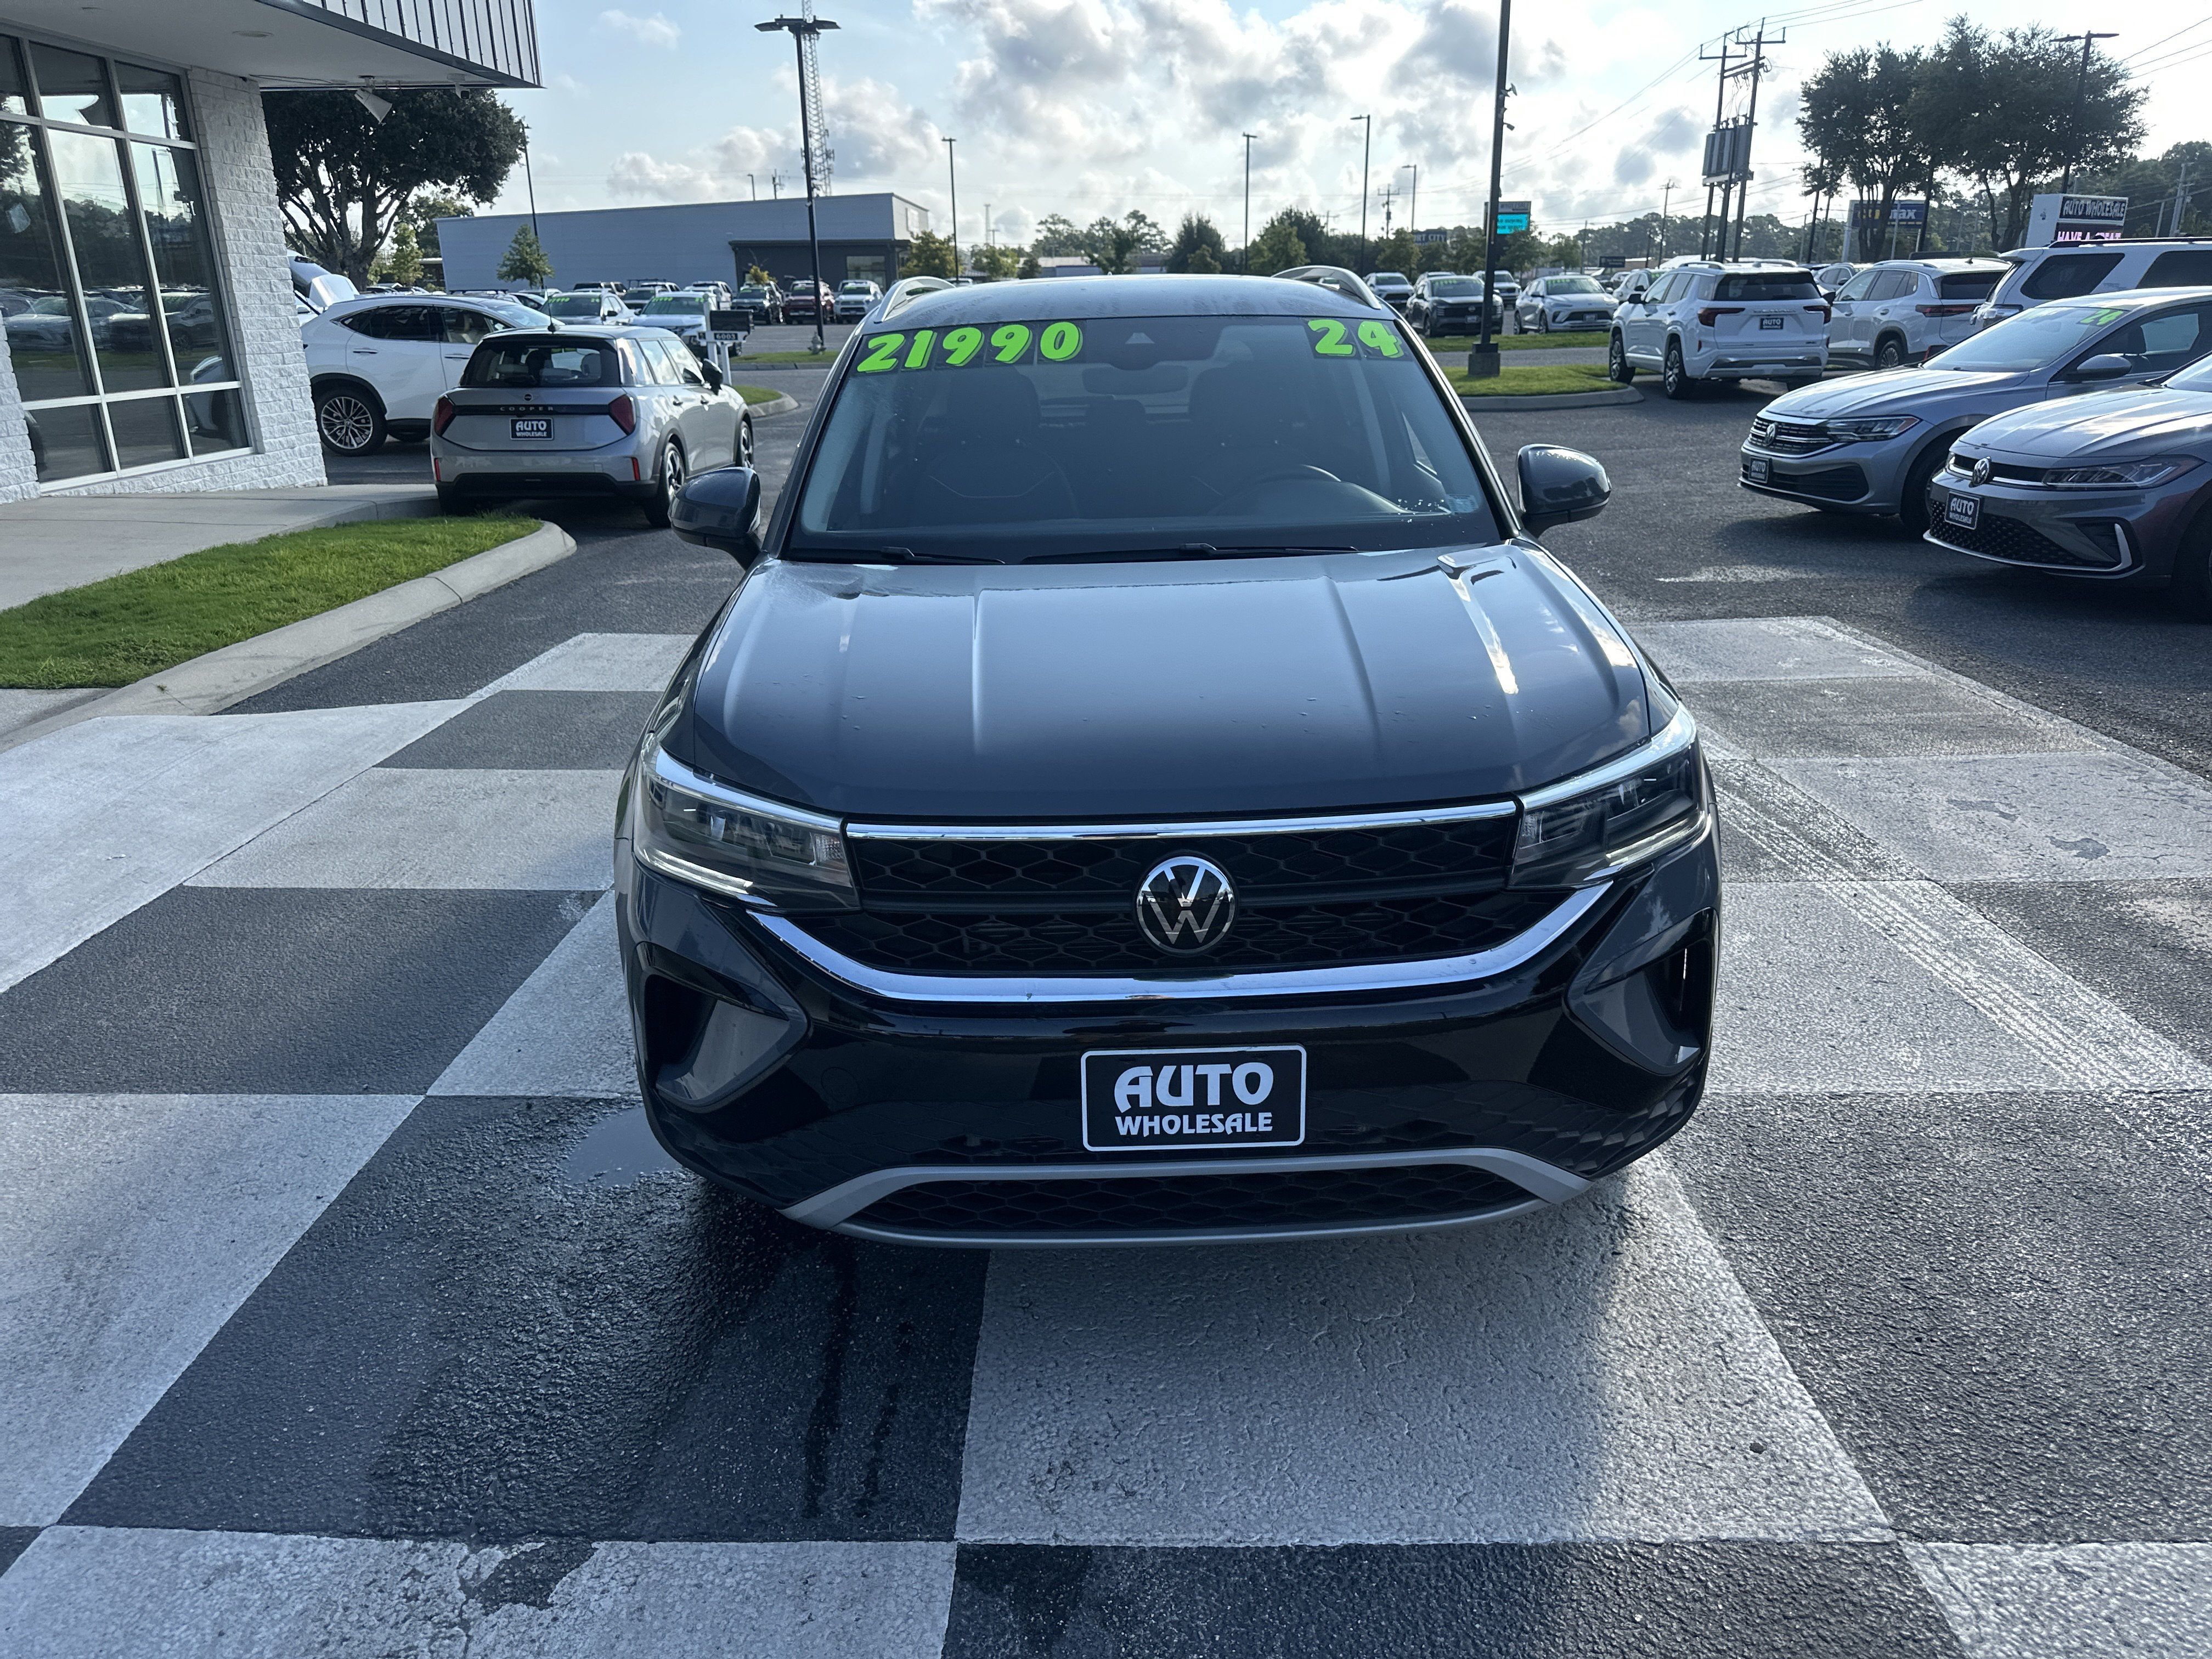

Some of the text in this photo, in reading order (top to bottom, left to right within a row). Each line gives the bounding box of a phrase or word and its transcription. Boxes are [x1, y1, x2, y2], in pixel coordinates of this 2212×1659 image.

[2063, 200, 2125, 218] AUTO WHOLESALE
[2057, 231, 2083, 241] HAVE
[2080, 309, 2124, 325] 24
[857, 319, 1403, 374] 21990 24
[516, 421, 547, 431] AUTO
[1950, 498, 1974, 515] AUTO
[1114, 1062, 1273, 1113] AUTO
[1115, 1112, 1273, 1137] WHOLESALE
